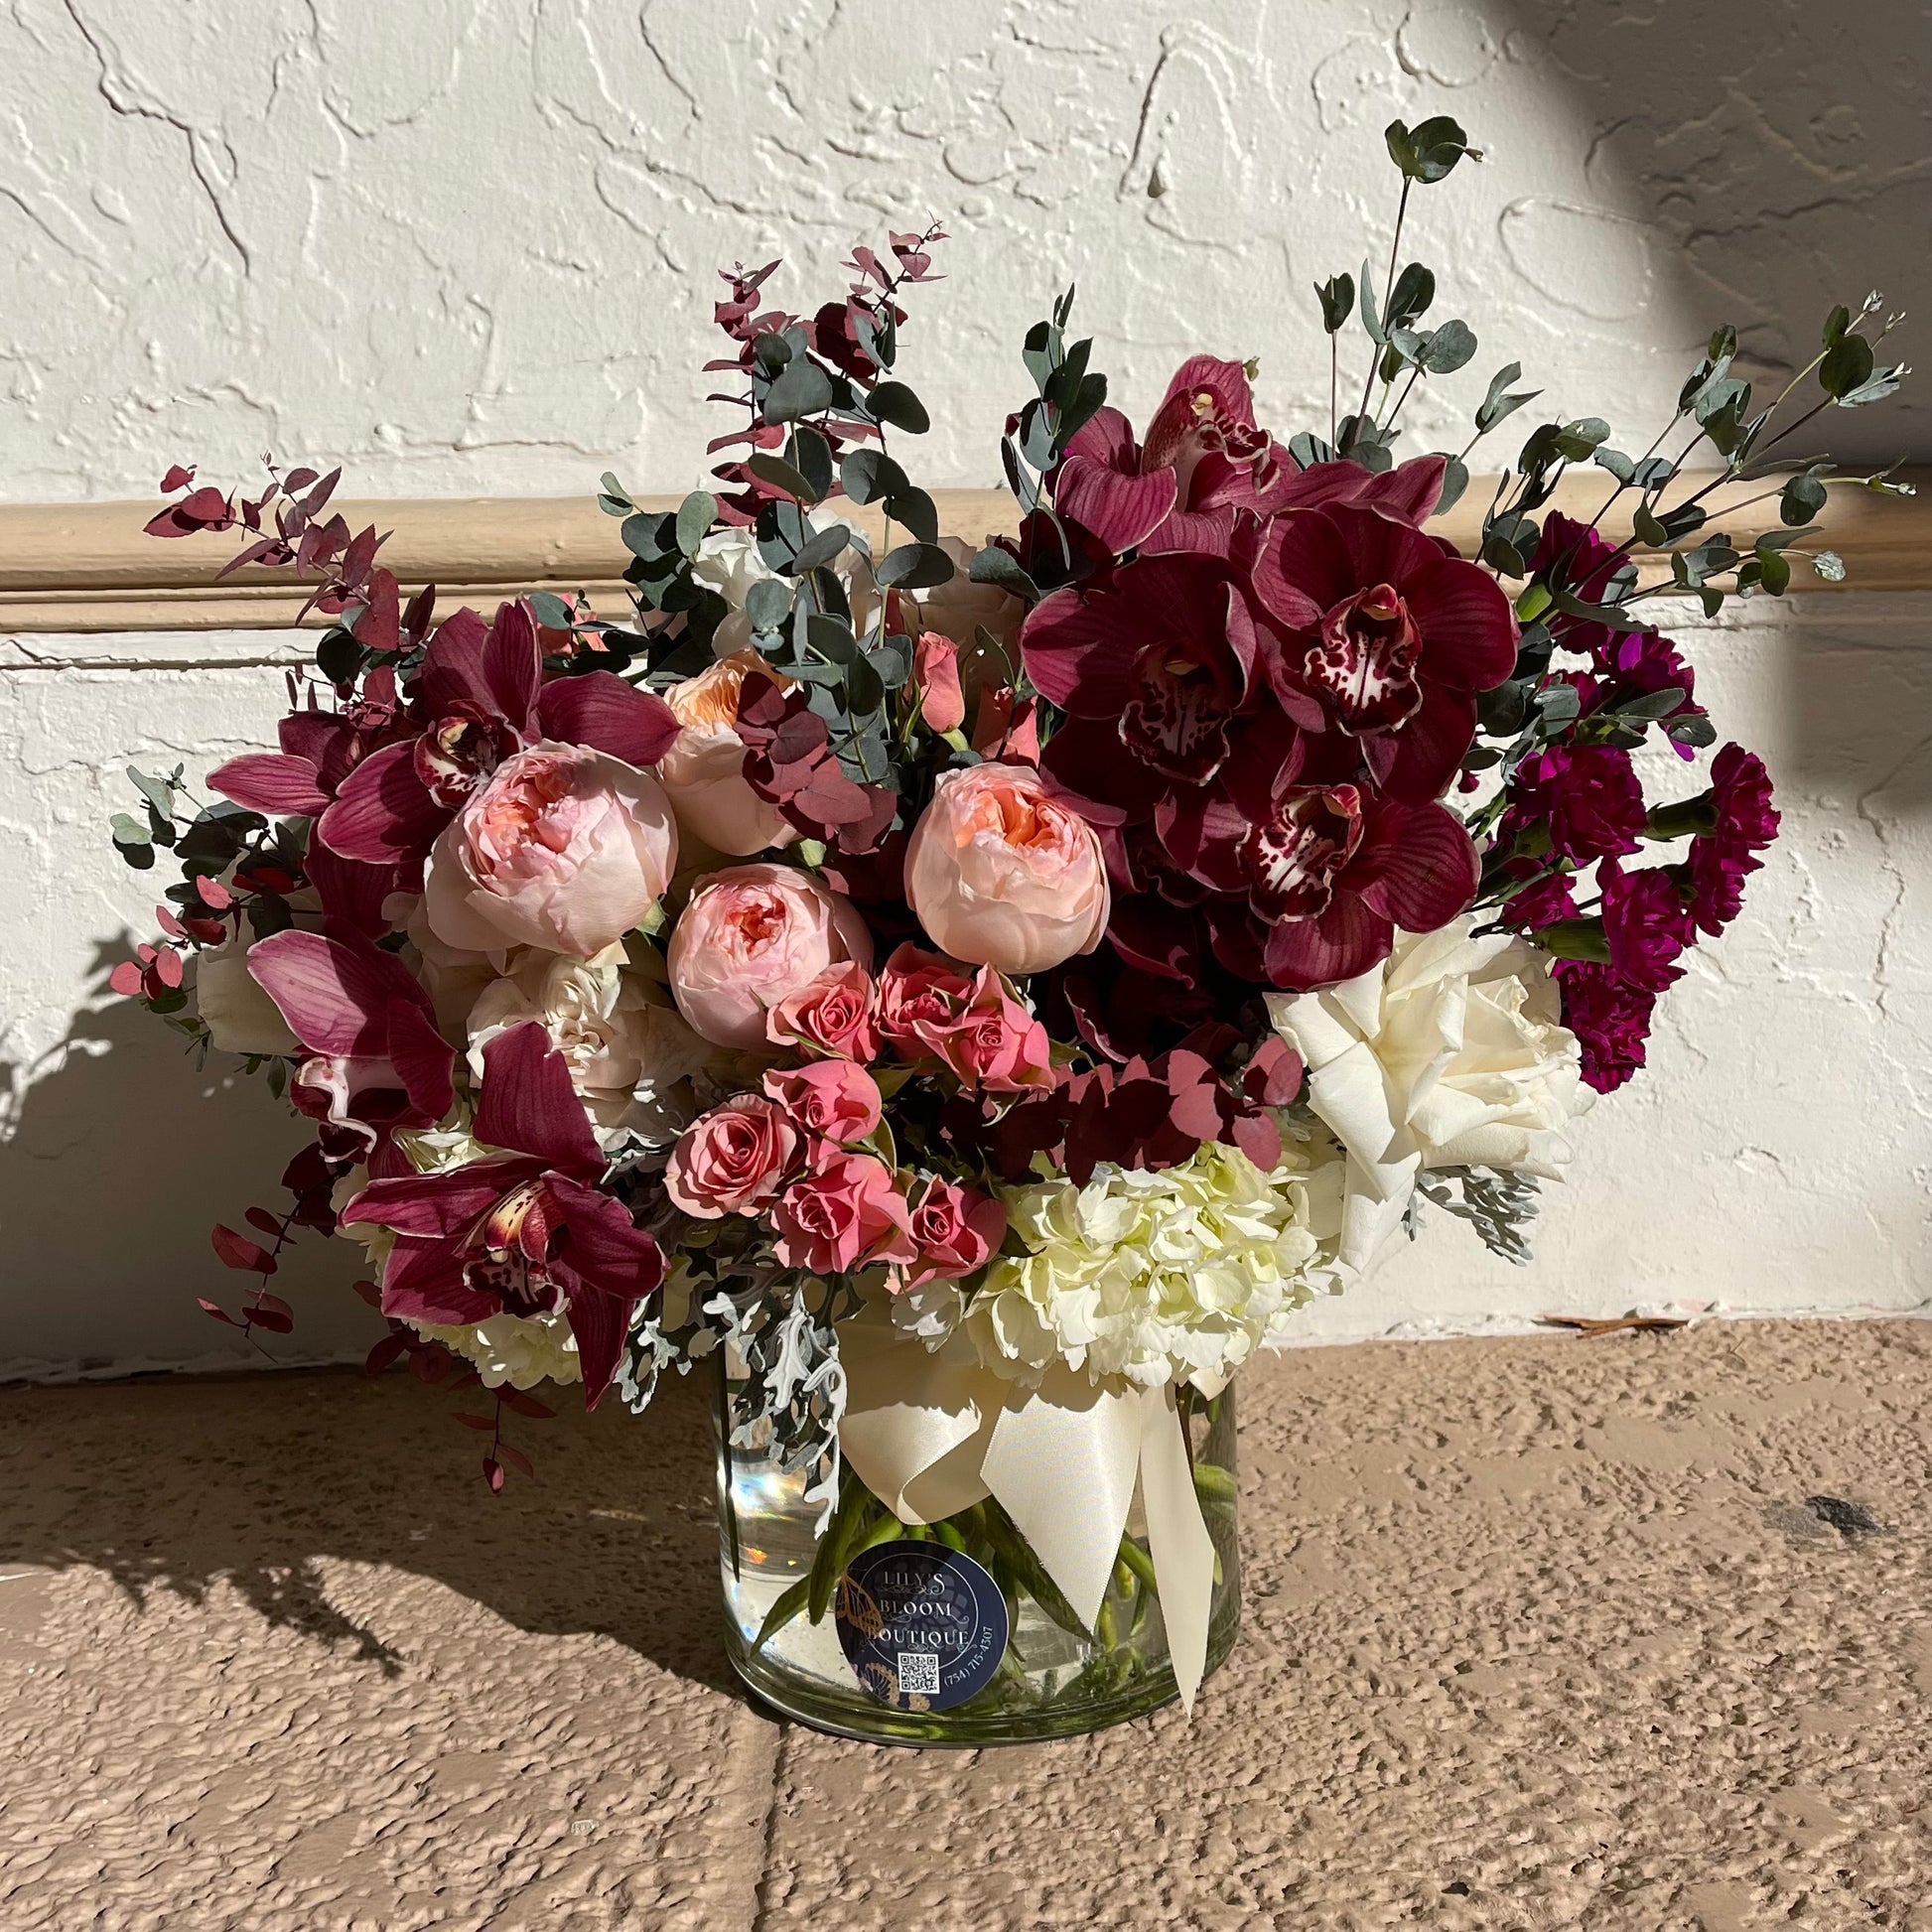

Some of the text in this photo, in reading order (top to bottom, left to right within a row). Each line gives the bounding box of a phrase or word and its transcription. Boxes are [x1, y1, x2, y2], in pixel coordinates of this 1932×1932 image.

[884, 1571, 945, 1593] LILY'S
[881, 1599, 957, 1618] BLOOM
[868, 1627, 969, 1648] BOUTIQUE
[944, 1626, 993, 1687] (754) 715-4307
